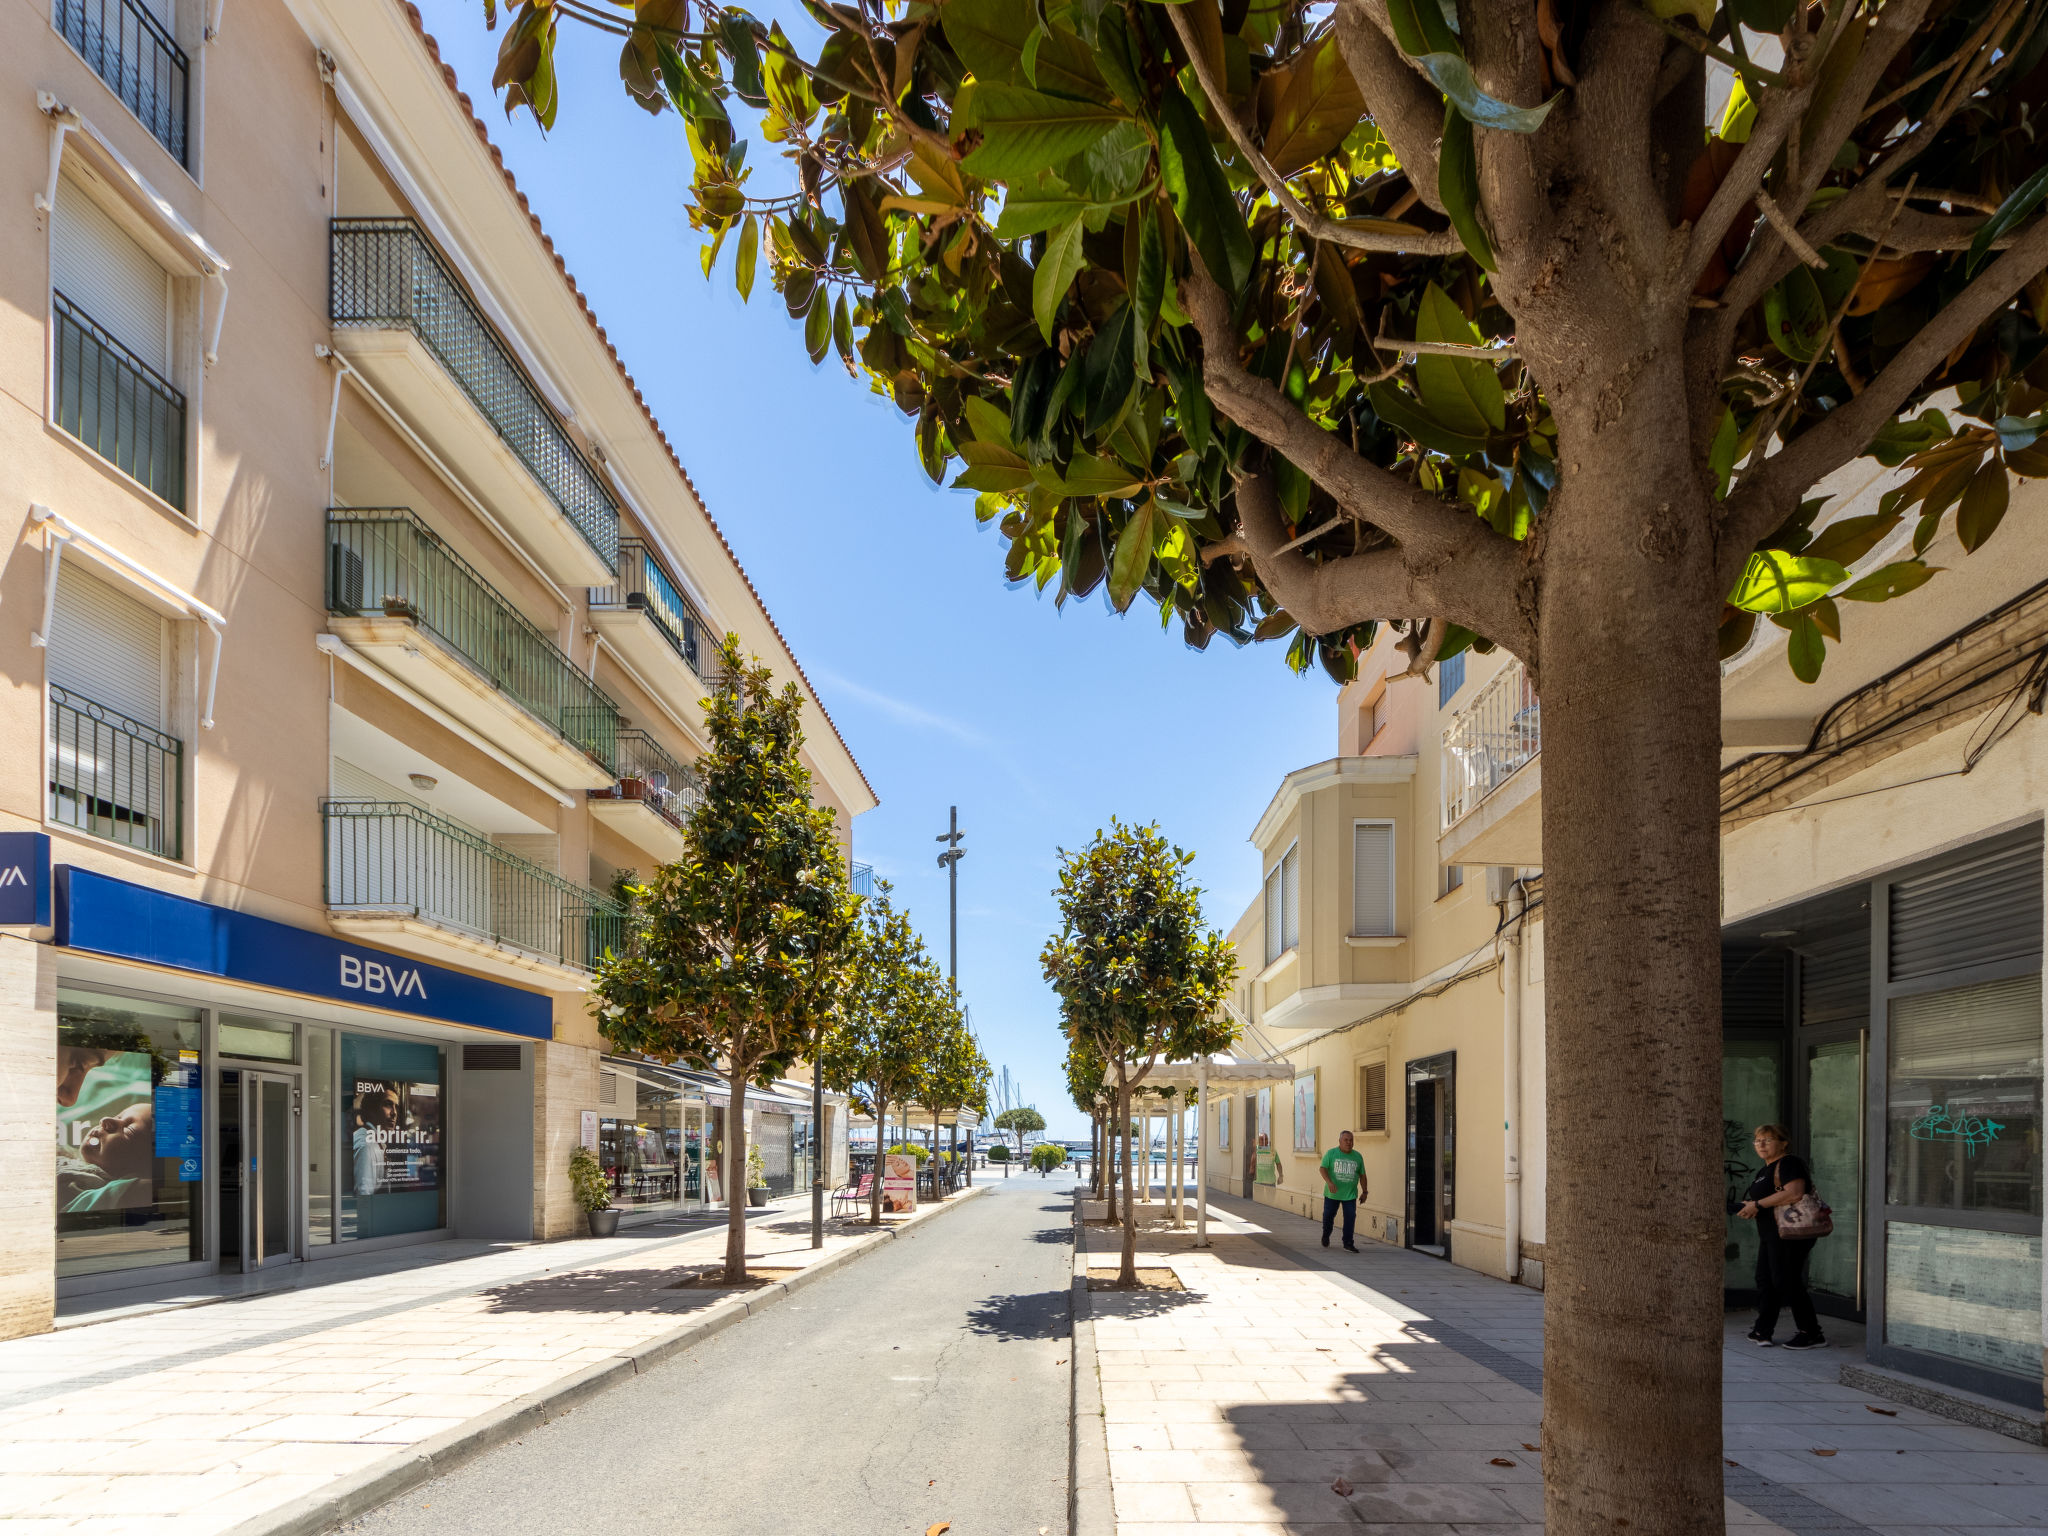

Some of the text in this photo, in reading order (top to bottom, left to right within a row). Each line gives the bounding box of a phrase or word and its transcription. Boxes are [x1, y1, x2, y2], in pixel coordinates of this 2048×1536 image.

[340, 954, 427, 999] BBVA
[357, 1082, 385, 1093] BBVA
[365, 1125, 431, 1144] abrir. ir.
